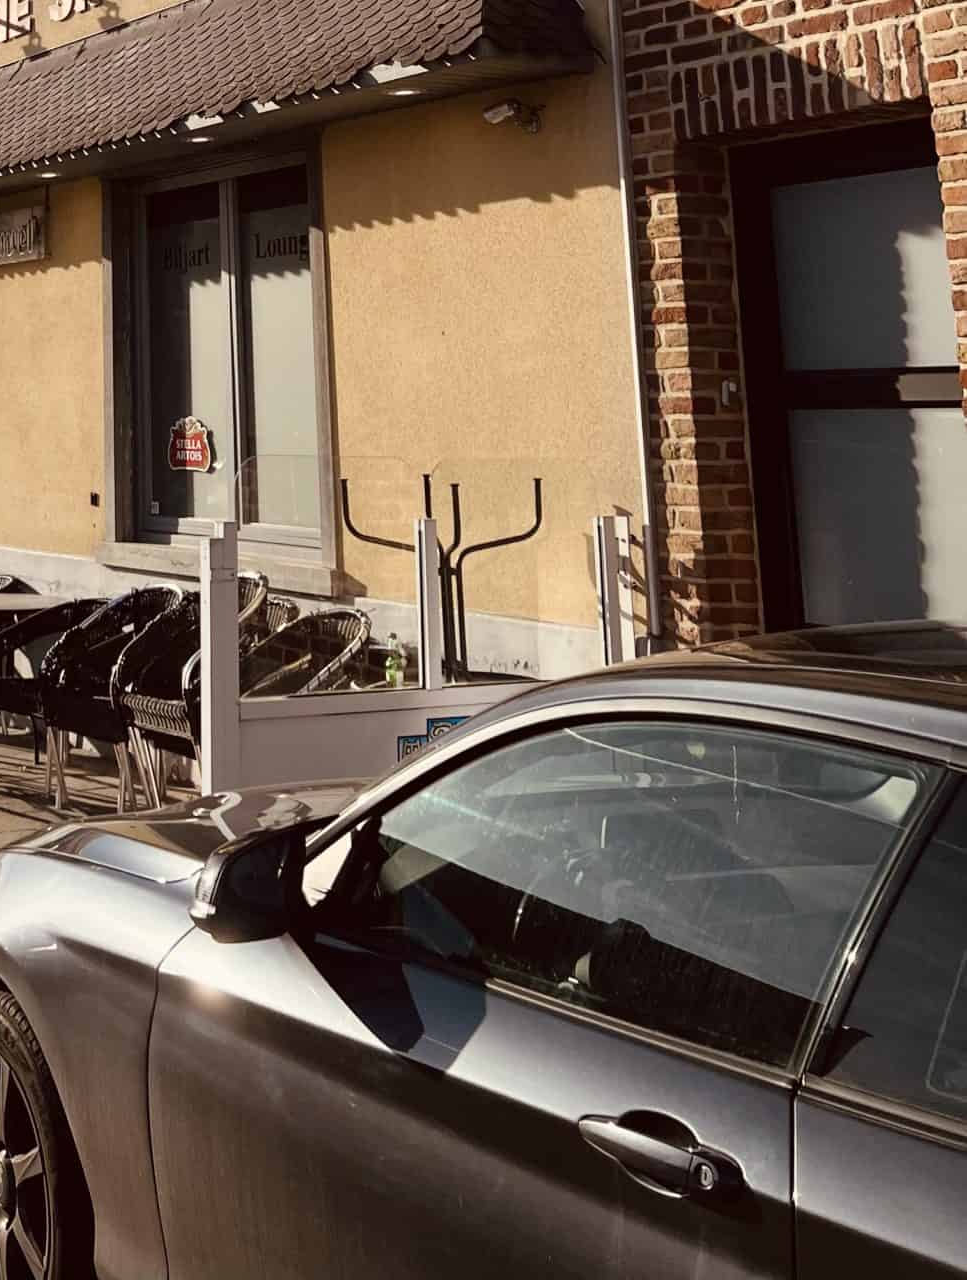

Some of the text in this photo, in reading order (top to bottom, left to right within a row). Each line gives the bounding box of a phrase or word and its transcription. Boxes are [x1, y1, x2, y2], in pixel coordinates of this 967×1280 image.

[255, 233, 310, 262] Loung
[176, 439, 202, 450] STELLA
[176, 450, 203, 461] ARTOIS
